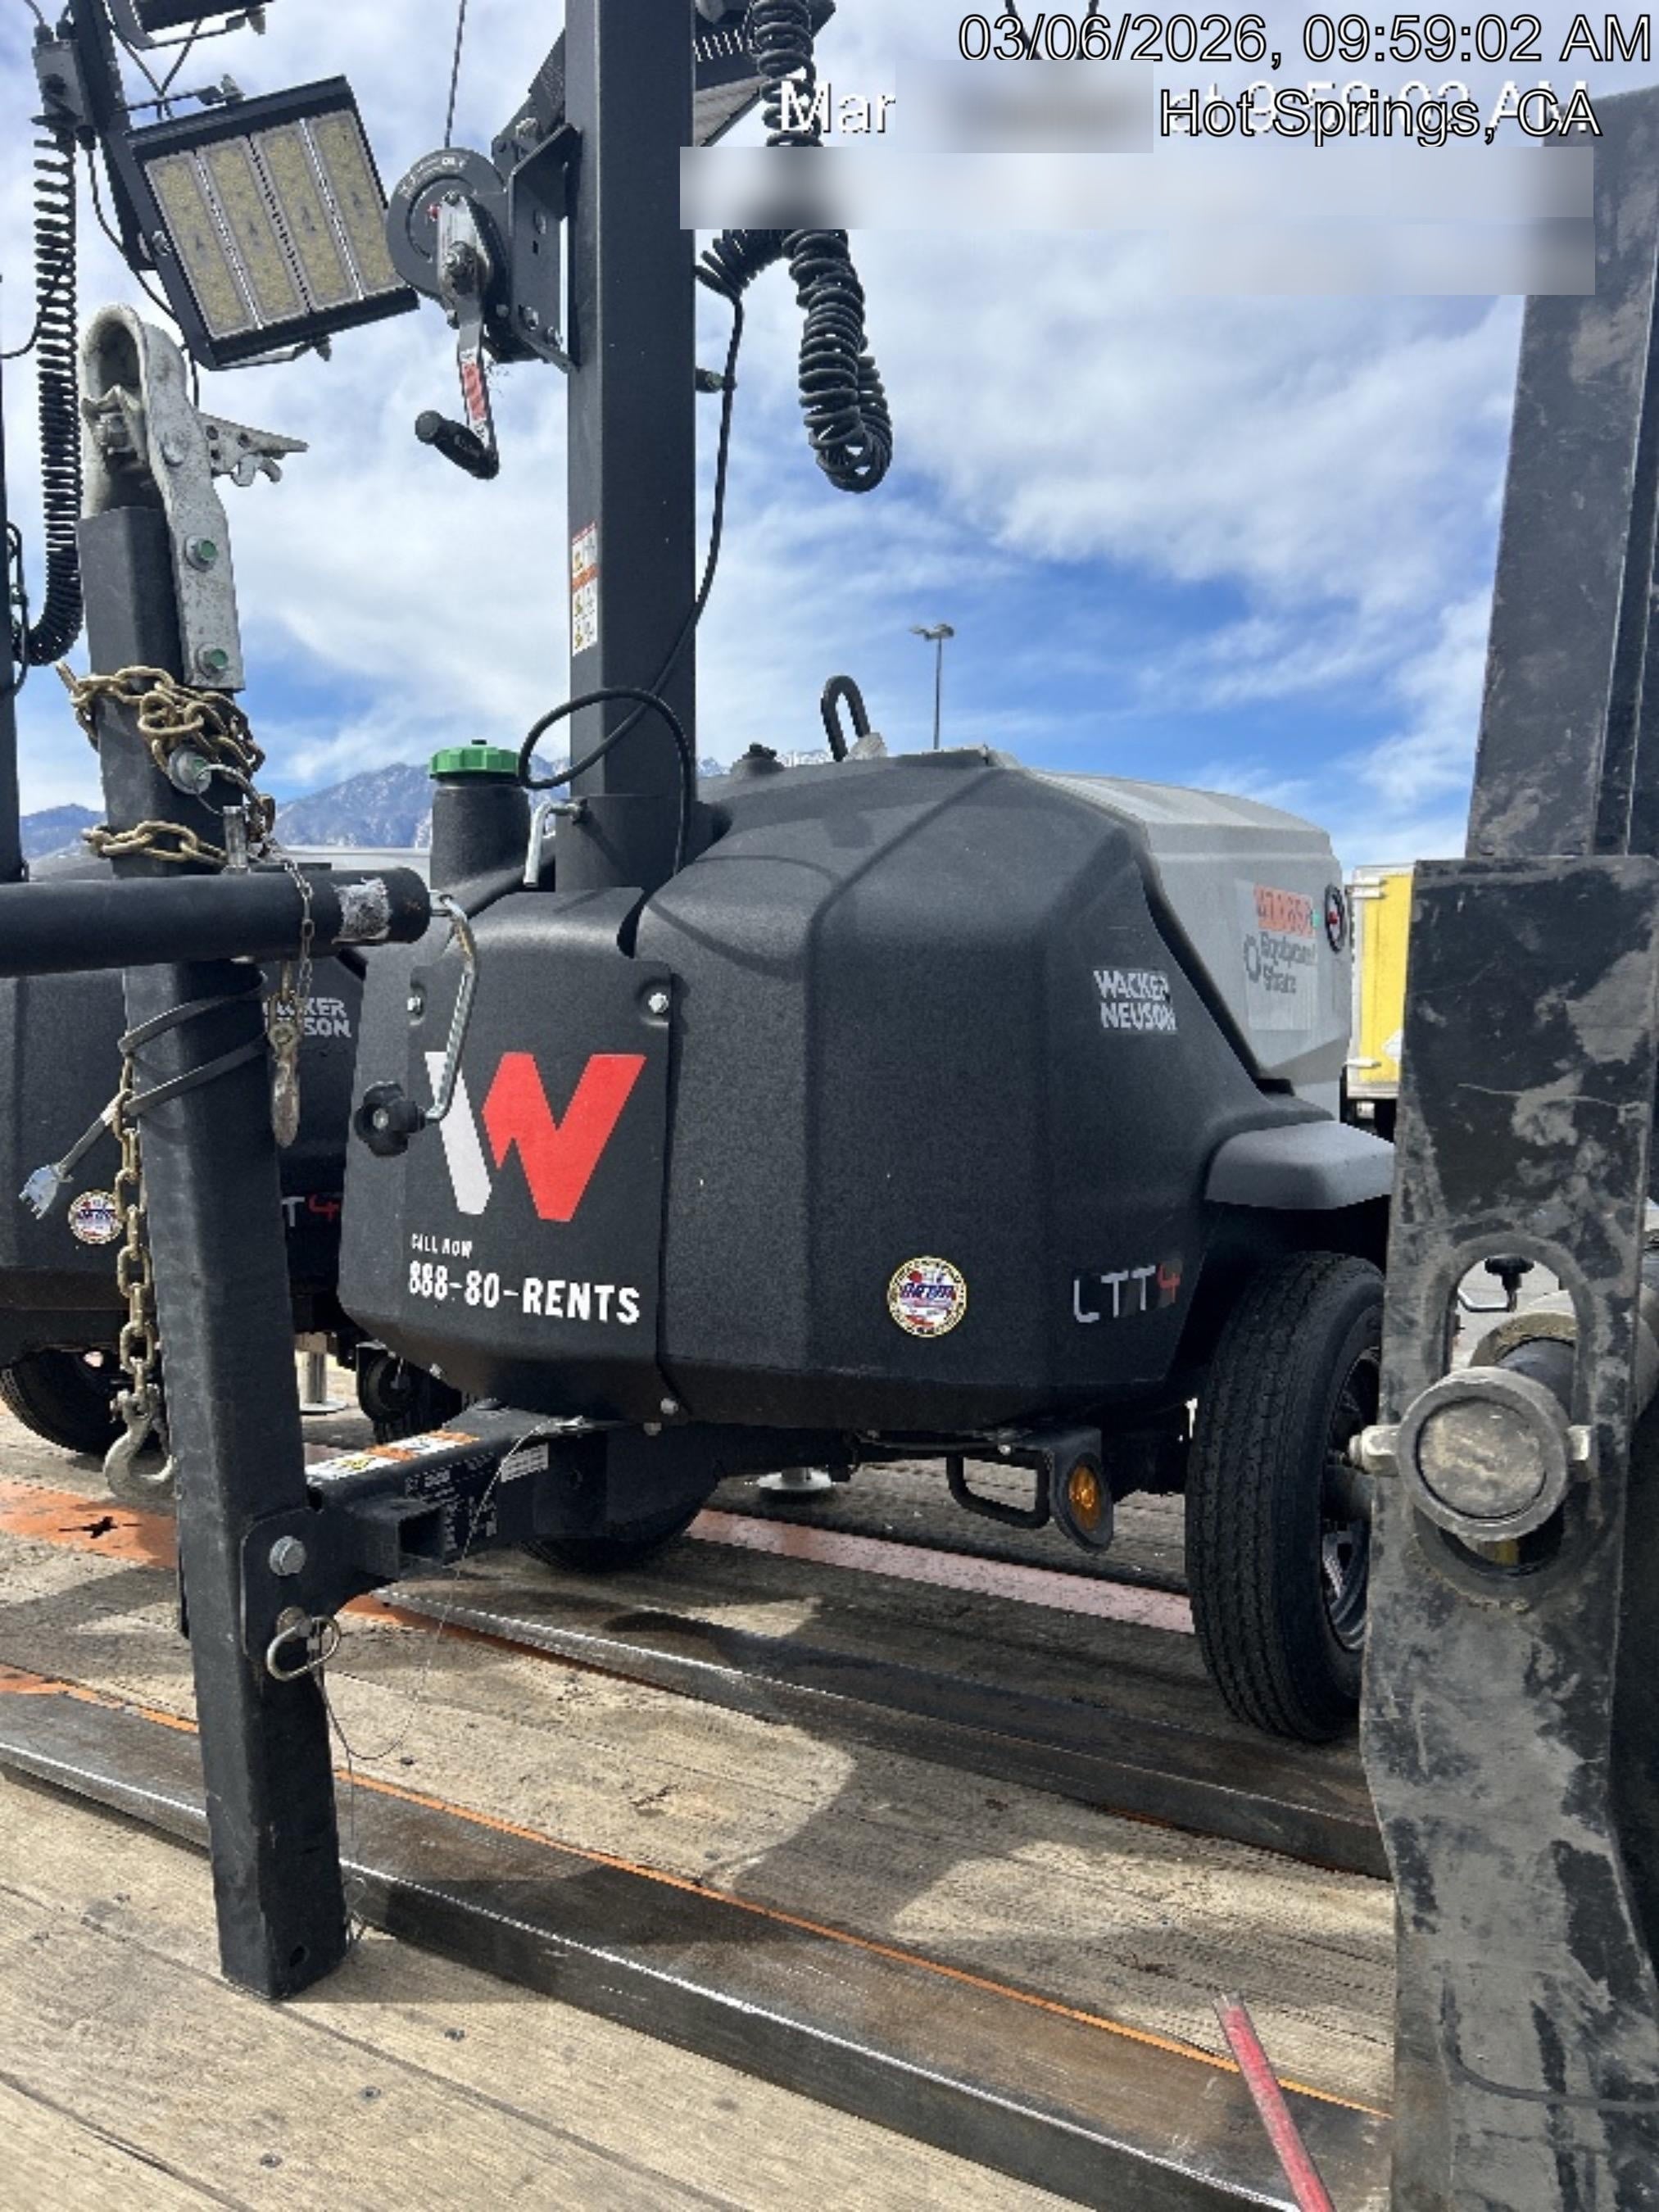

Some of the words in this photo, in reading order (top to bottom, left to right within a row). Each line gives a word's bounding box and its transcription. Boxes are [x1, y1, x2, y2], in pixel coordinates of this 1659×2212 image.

[1093, 970, 1170, 1001] WACKER
[1099, 1002, 1178, 1031] NEUSON
[410, 1233, 438, 1254] CALL
[442, 1238, 474, 1259] NOW
[409, 1260, 641, 1326] 888-80-RENTS
[1073, 1261, 1181, 1324] LTT4
